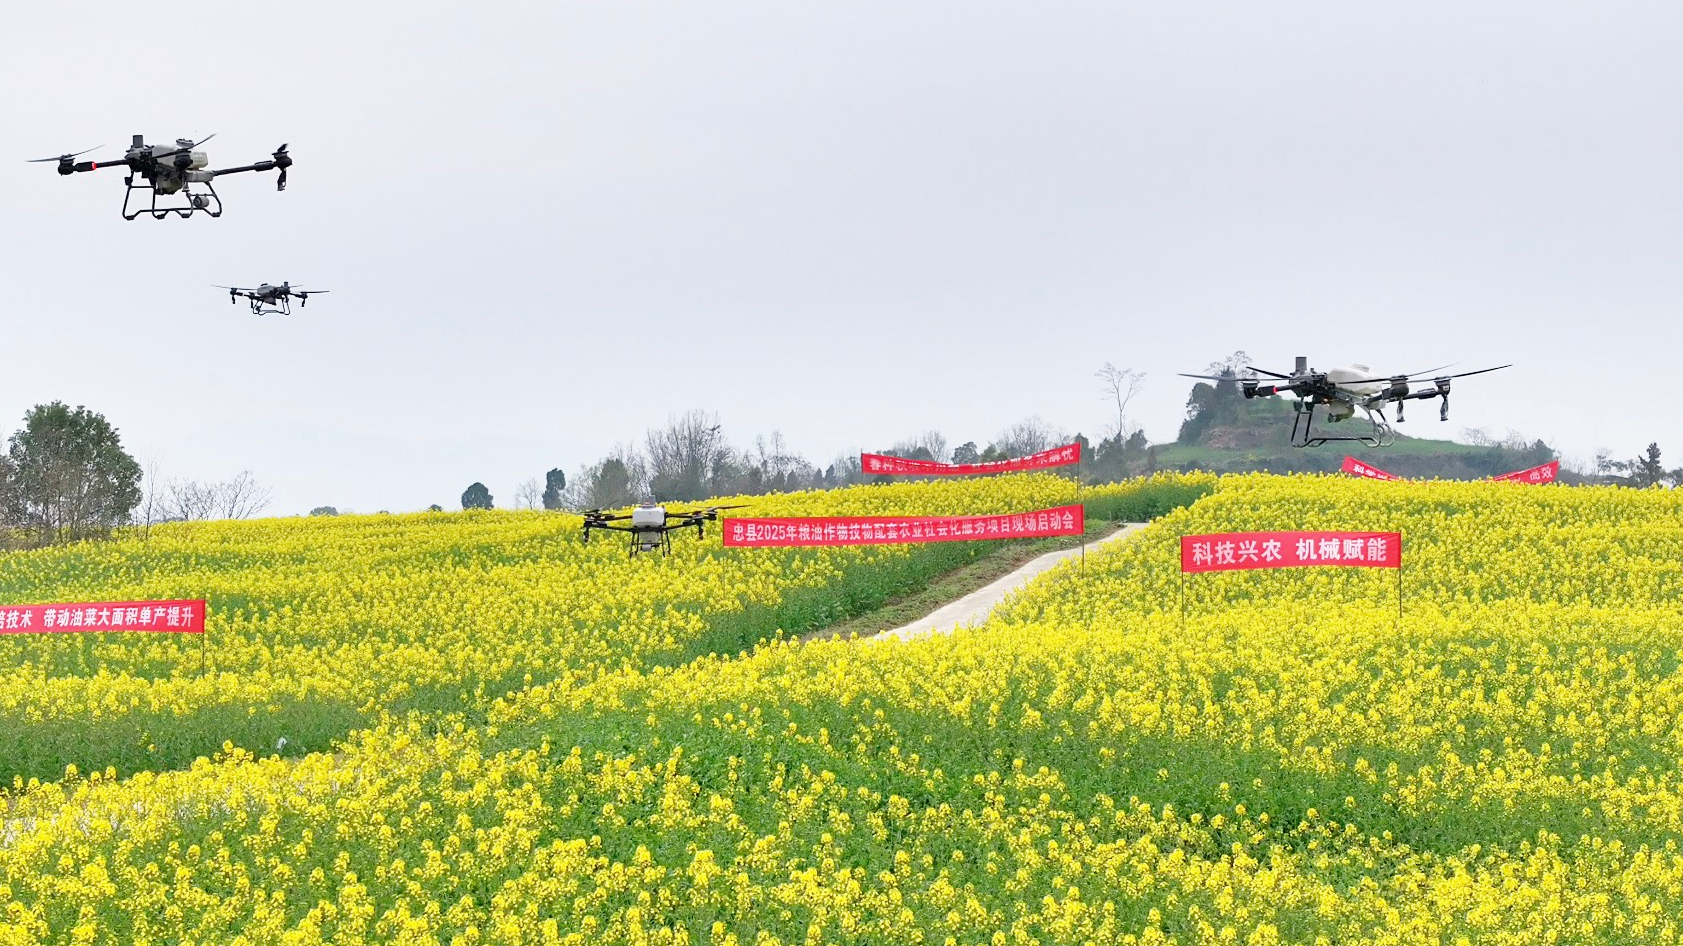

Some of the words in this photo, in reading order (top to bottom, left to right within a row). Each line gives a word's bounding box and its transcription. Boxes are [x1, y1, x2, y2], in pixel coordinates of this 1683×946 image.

[733, 510, 1074, 542] 忠县2025年粮油作物技物配套农业社会化服务项目现场启动会
[1192, 539, 1282, 566] 科技兴农
[1295, 538, 1387, 561] 机械赋能
[44, 606, 194, 628] 带动油菜大面积单产提升
